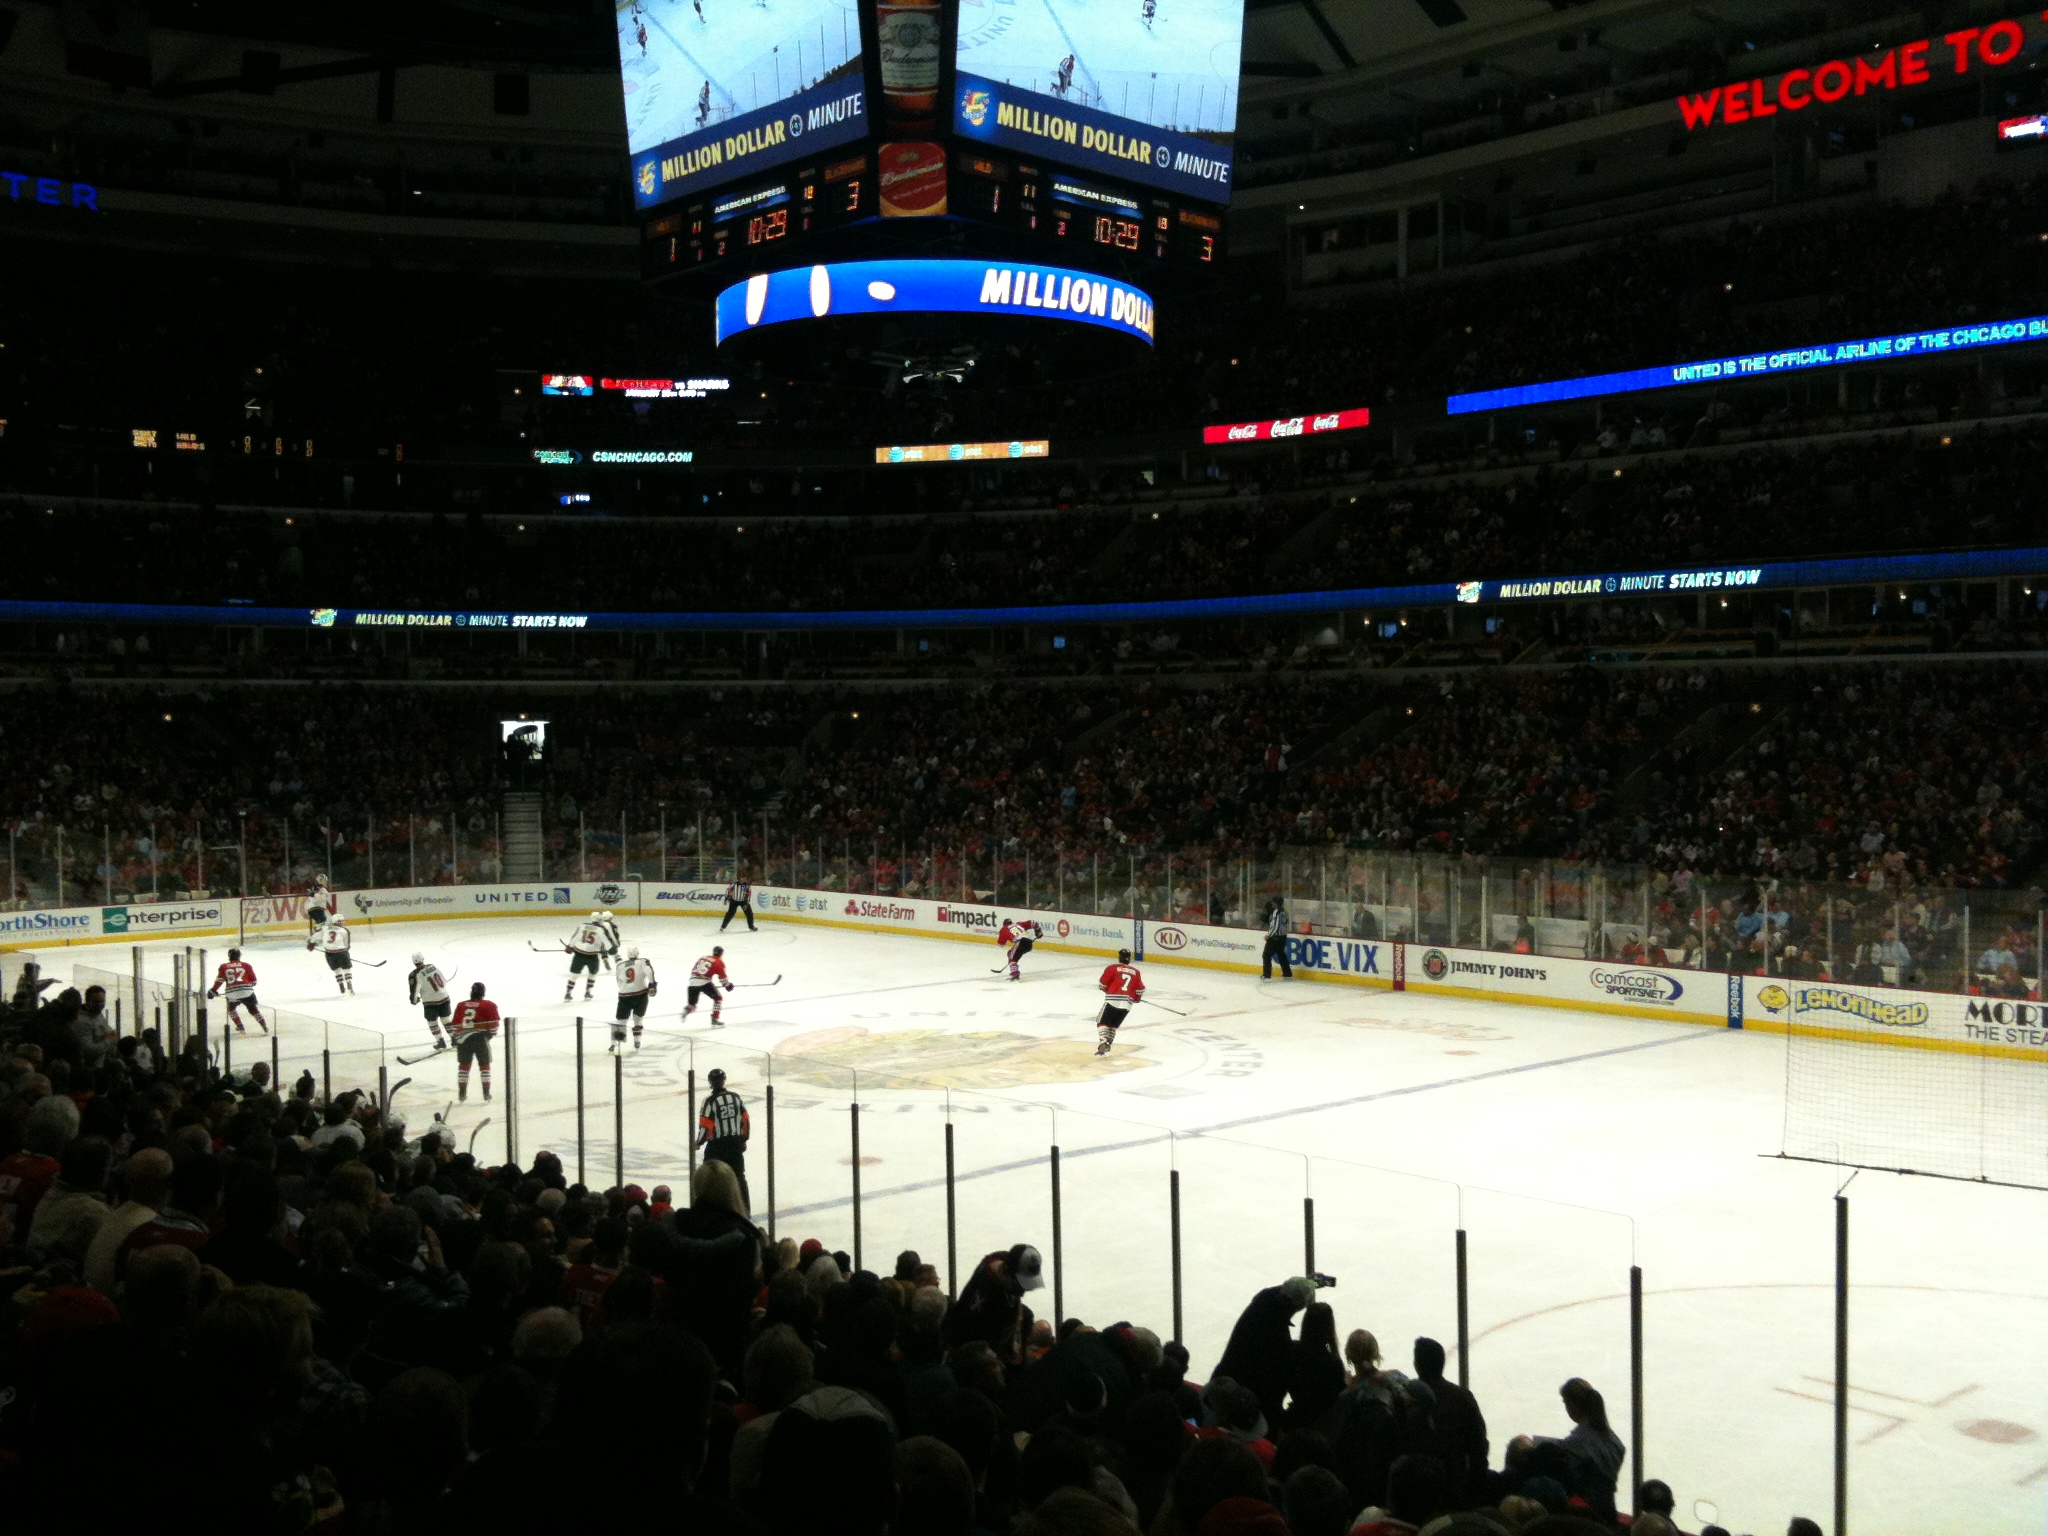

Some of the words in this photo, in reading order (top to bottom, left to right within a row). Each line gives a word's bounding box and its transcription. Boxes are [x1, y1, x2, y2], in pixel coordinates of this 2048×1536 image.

[1676, 39, 1931, 131] WELCOME
[1944, 20, 2026, 75] TO
[661, 140, 723, 183] MILLION
[725, 119, 787, 163] DOLLAR
[807, 92, 863, 133] MINUTE
[996, 101, 1078, 145] MILLION
[1081, 124, 1152, 166] DOLLAR
[1172, 150, 1230, 185] MINUTE
[1, 170, 101, 212] TER
[713, 194, 752, 215] AMERICAN
[751, 184, 787, 204] EXPRESS
[1053, 182, 1100, 202] AMERICAN
[1100, 190, 1139, 210] EXPRESS
[1094, 215, 1140, 250] 10:29
[980, 268, 1107, 318] MILLION
[1673, 361, 1721, 382] UNITED
[1722, 360, 1738, 377] IS
[1740, 355, 1767, 374] THE
[1768, 346, 1833, 371] OFFICIAL
[1834, 338, 1893, 362] AIRLINE
[1894, 334, 1917, 353] OF
[1918, 330, 1951, 350] THE
[1952, 322, 2027, 345] CHICAGO
[592, 451, 694, 463] CSNCHICAGO.COM
[1499, 582, 1551, 599] MILLION
[1552, 578, 1602, 595] DOLLAR
[1619, 574, 1667, 591] MINUTE
[1669, 571, 1724, 590] STARTS
[1724, 568, 1762, 587] NOW
[355, 613, 406, 626] MILLION
[406, 614, 453, 627] DOLLAR
[468, 614, 510, 626] MINUTE
[511, 615, 557, 628] STARTS
[558, 615, 588, 628] NOW
[376, 899, 413, 908] University
[475, 892, 549, 905] UNITED
[104, 907, 220, 930] enterprise
[946, 904, 998, 929] impact
[329, 931, 337, 945] 3
[1071, 924, 1100, 937] Harris
[1101, 927, 1126, 940] Bank
[1160, 931, 1182, 946] KIA
[1336, 941, 1379, 976] VIX
[225, 967, 246, 984] 67
[625, 967, 636, 984] 9
[1449, 960, 1498, 976] JIMMY
[1499, 966, 1548, 982] JOHN'S
[1595, 972, 1659, 989] comcast
[1121, 973, 1132, 992] 7
[1605, 985, 1666, 1000] SPORTSNET
[1729, 976, 1740, 1020] Reebok
[462, 1008, 477, 1029] 2
[1964, 1024, 2000, 1041] THE
[720, 1104, 736, 1120] 26
